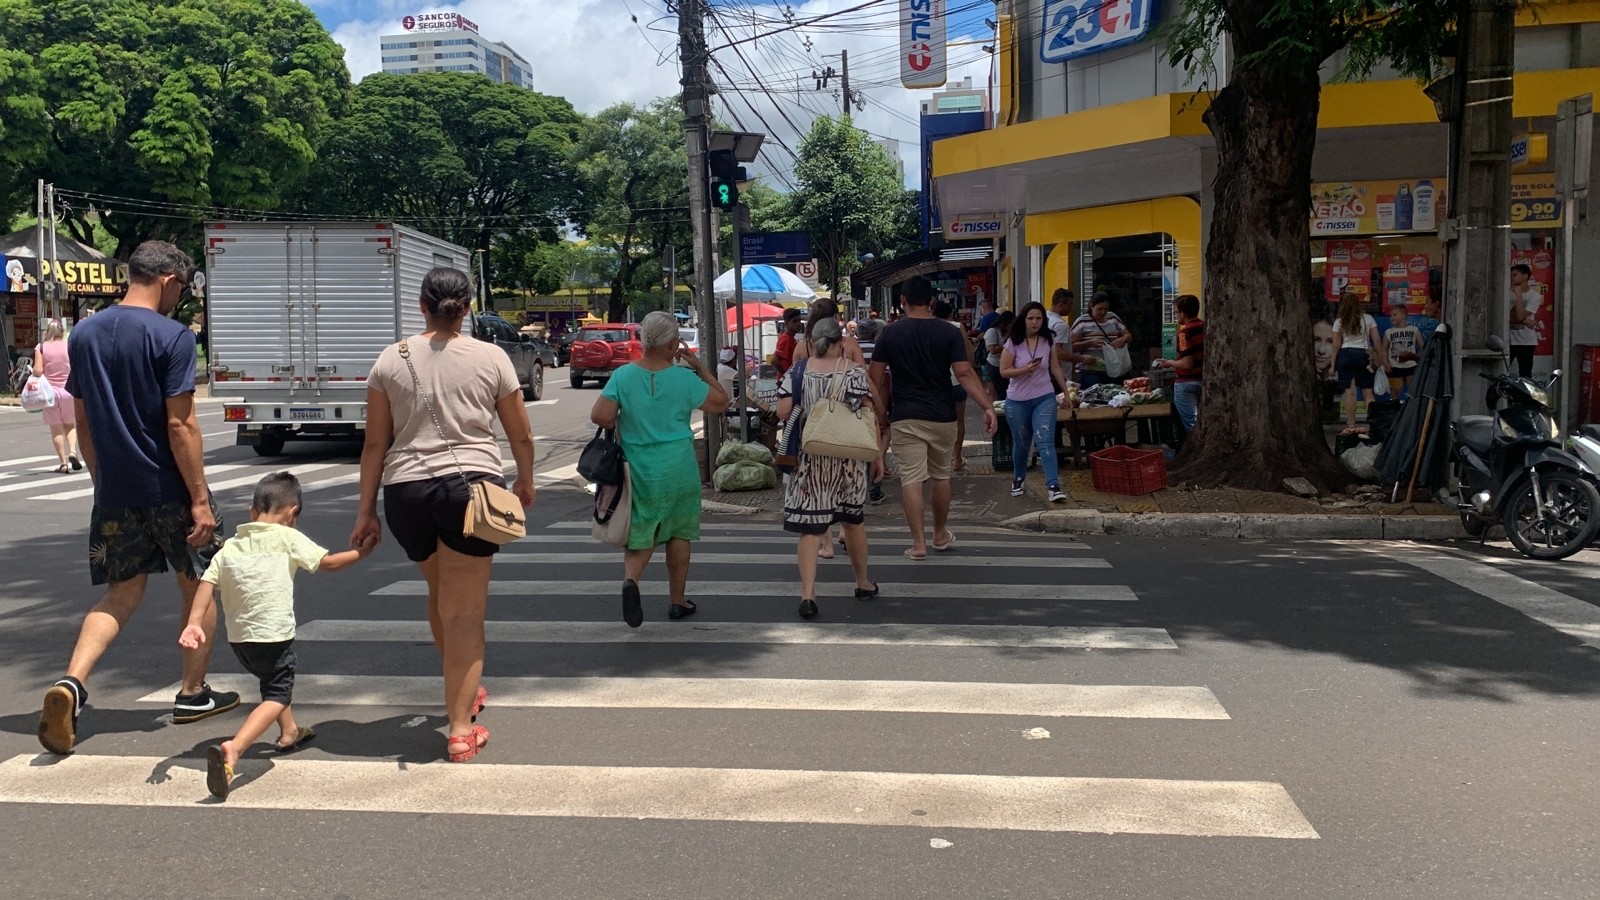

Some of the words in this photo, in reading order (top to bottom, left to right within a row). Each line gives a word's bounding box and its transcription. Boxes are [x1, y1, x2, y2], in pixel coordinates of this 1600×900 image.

[417, 12, 456, 21] SANCOR
[418, 21, 457, 30] SEGUROS
[964, 221, 1002, 232] nissei
[1325, 221, 1356, 230] nissei
[743, 236, 764, 245] Brasil
[41, 259, 112, 284] PASTEL
[68, 284, 76, 292] DE
[77, 284, 95, 292] CANA
[1390, 330, 1415, 341] MIAMI
